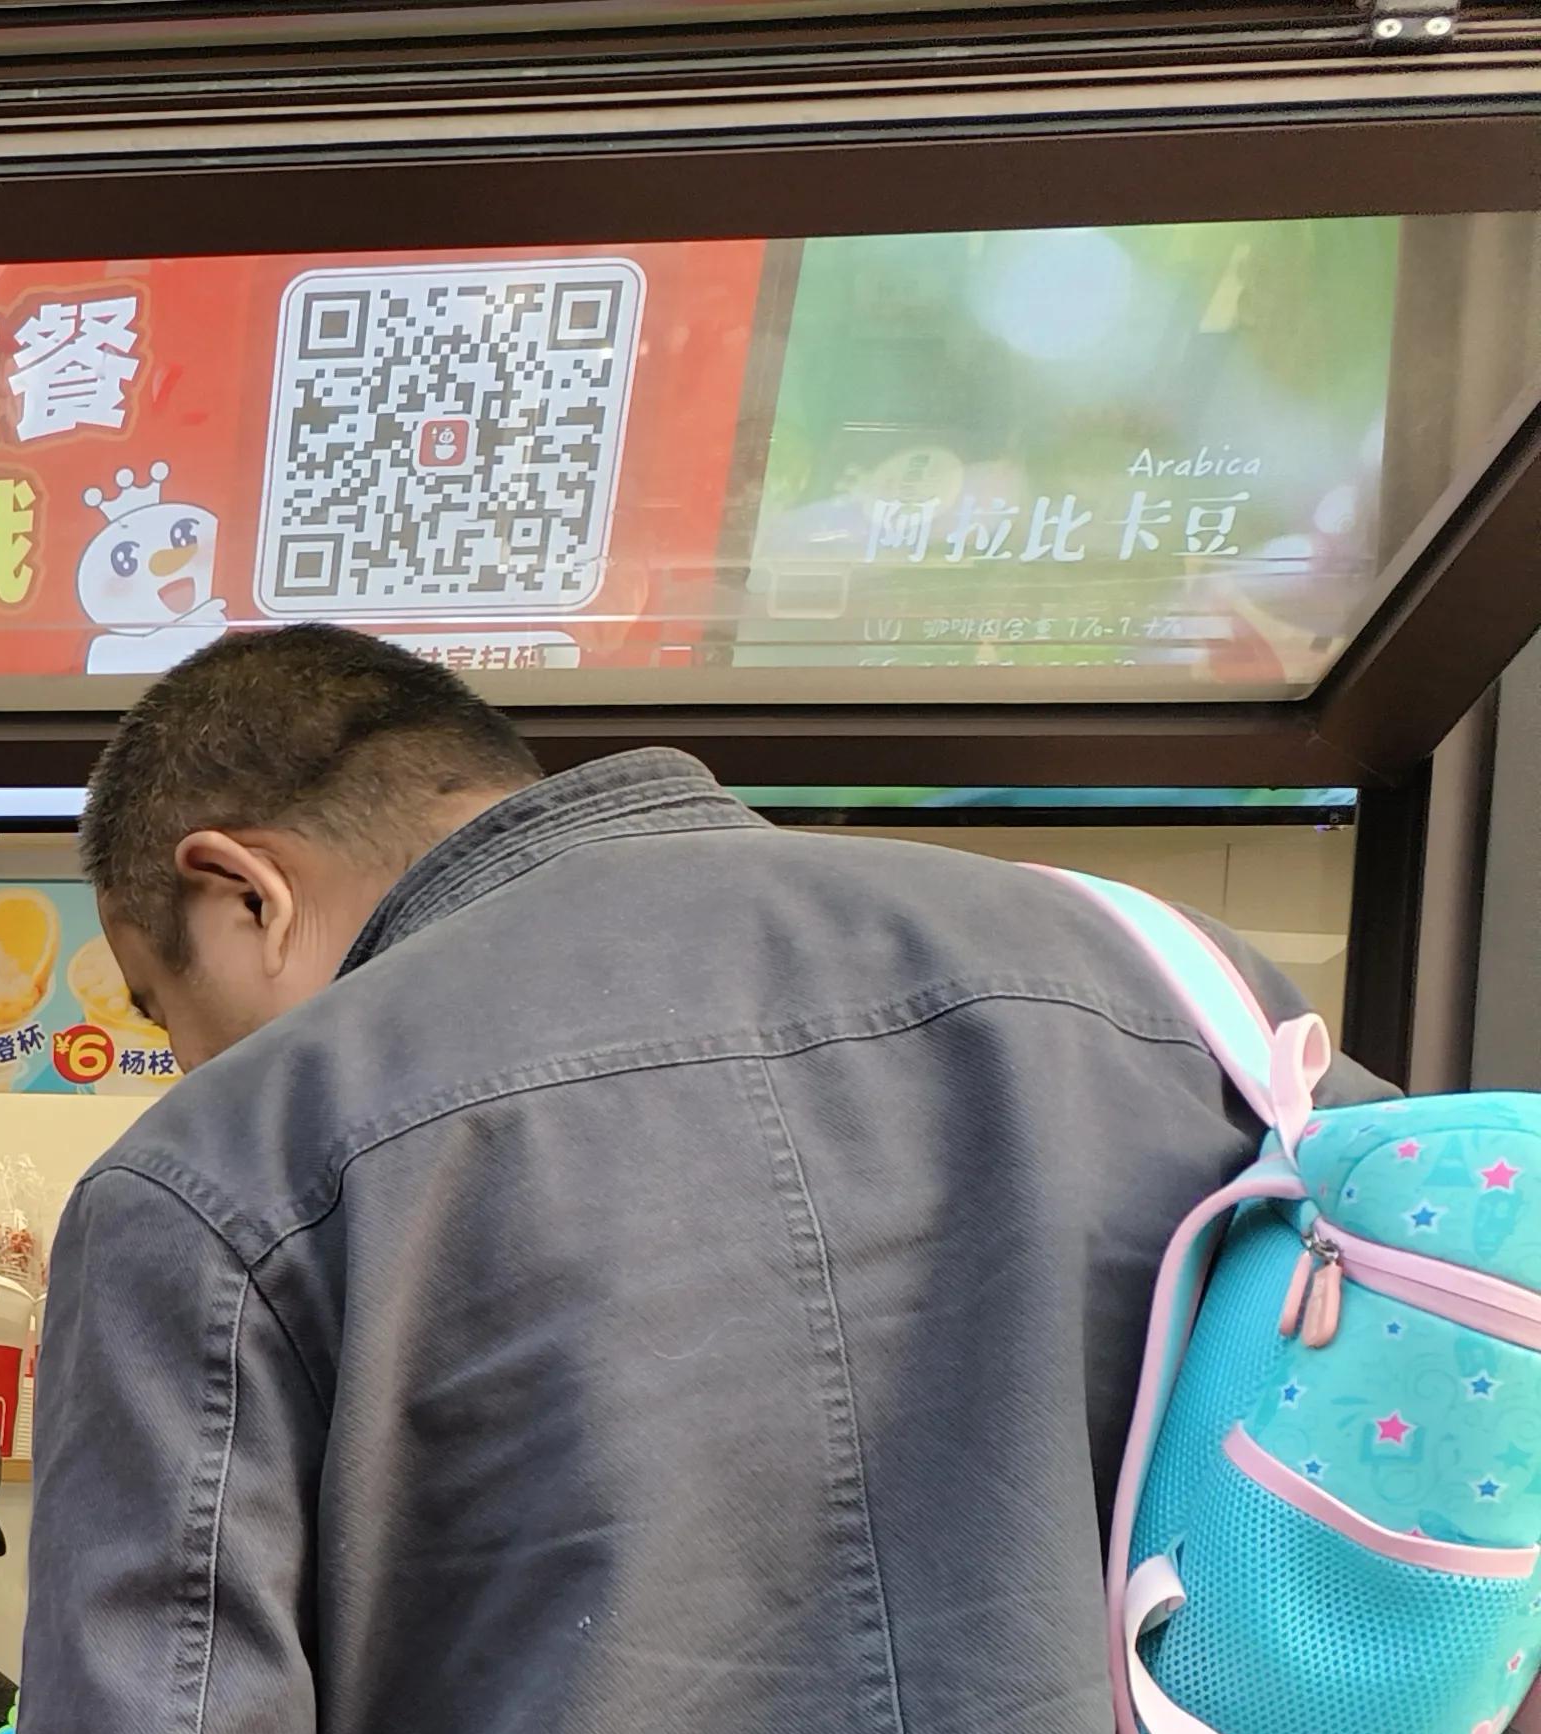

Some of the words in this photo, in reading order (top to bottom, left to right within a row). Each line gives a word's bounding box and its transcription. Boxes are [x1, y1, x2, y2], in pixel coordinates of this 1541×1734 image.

[1128, 447, 1262, 479] Arabica
[864, 490, 1252, 563] 阿拉比卡豆
